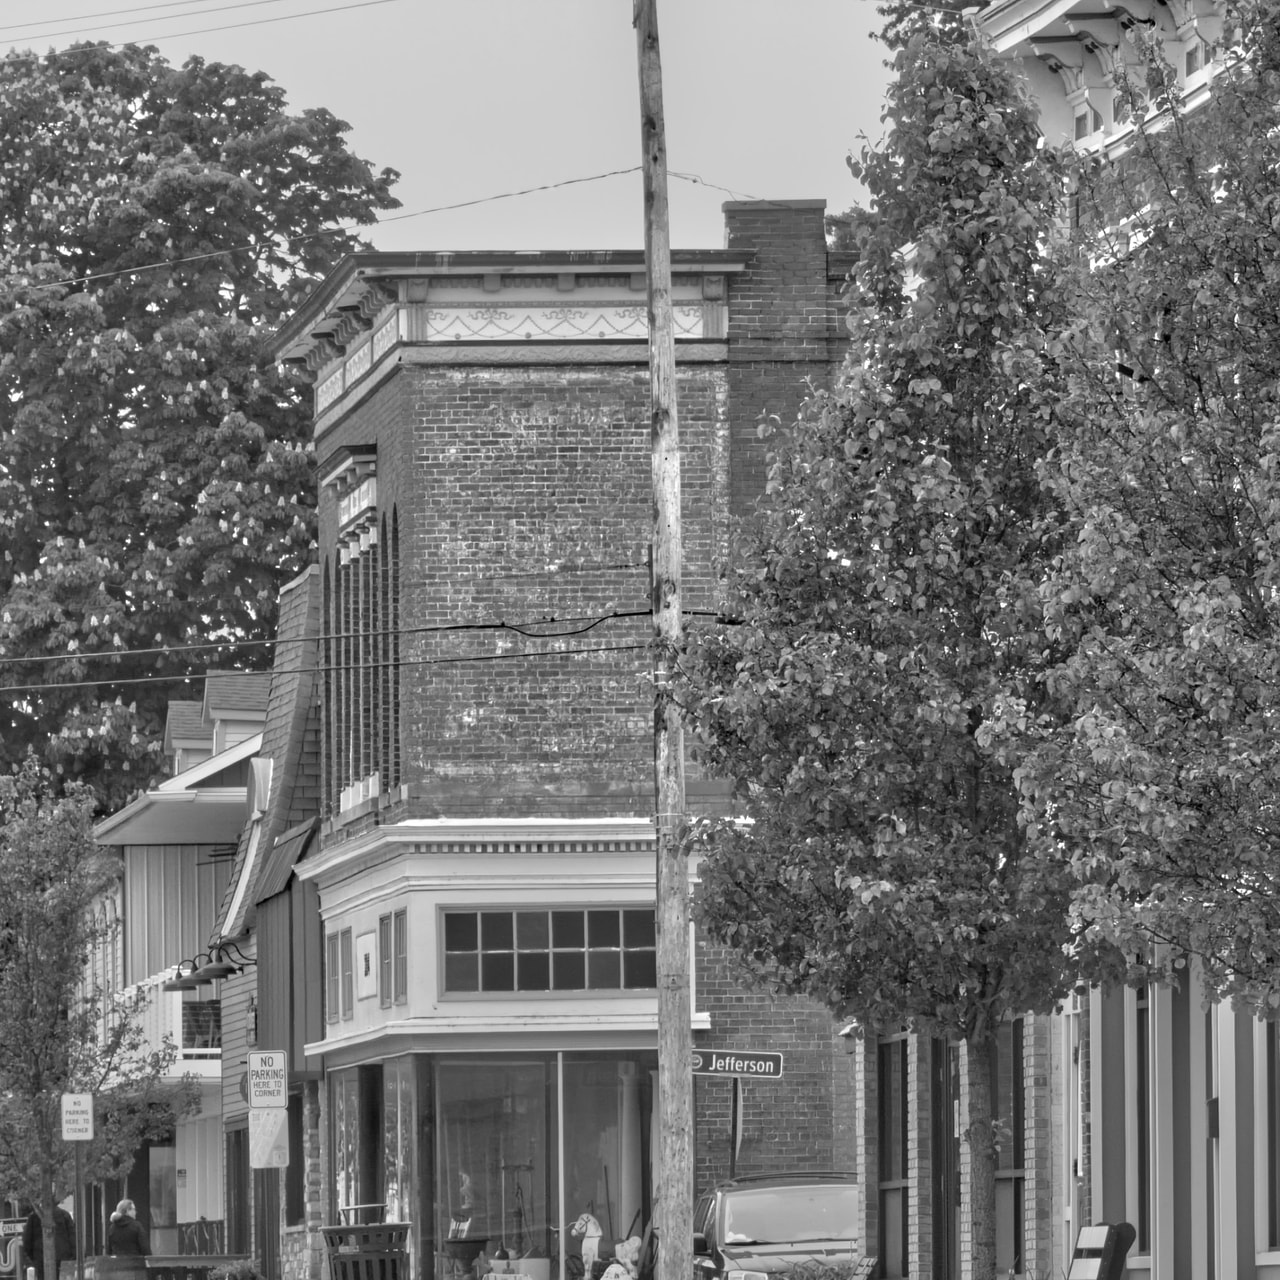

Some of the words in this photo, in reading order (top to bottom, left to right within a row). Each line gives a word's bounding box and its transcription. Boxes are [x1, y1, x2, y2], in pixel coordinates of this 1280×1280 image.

[260, 1056, 274, 1068] NO
[708, 1054, 774, 1073] Jefferson
[251, 1069, 284, 1081] PARKING
[253, 1081, 271, 1089] HERE
[274, 1080, 282, 1088] TO
[254, 1089, 282, 1097] CORNER
